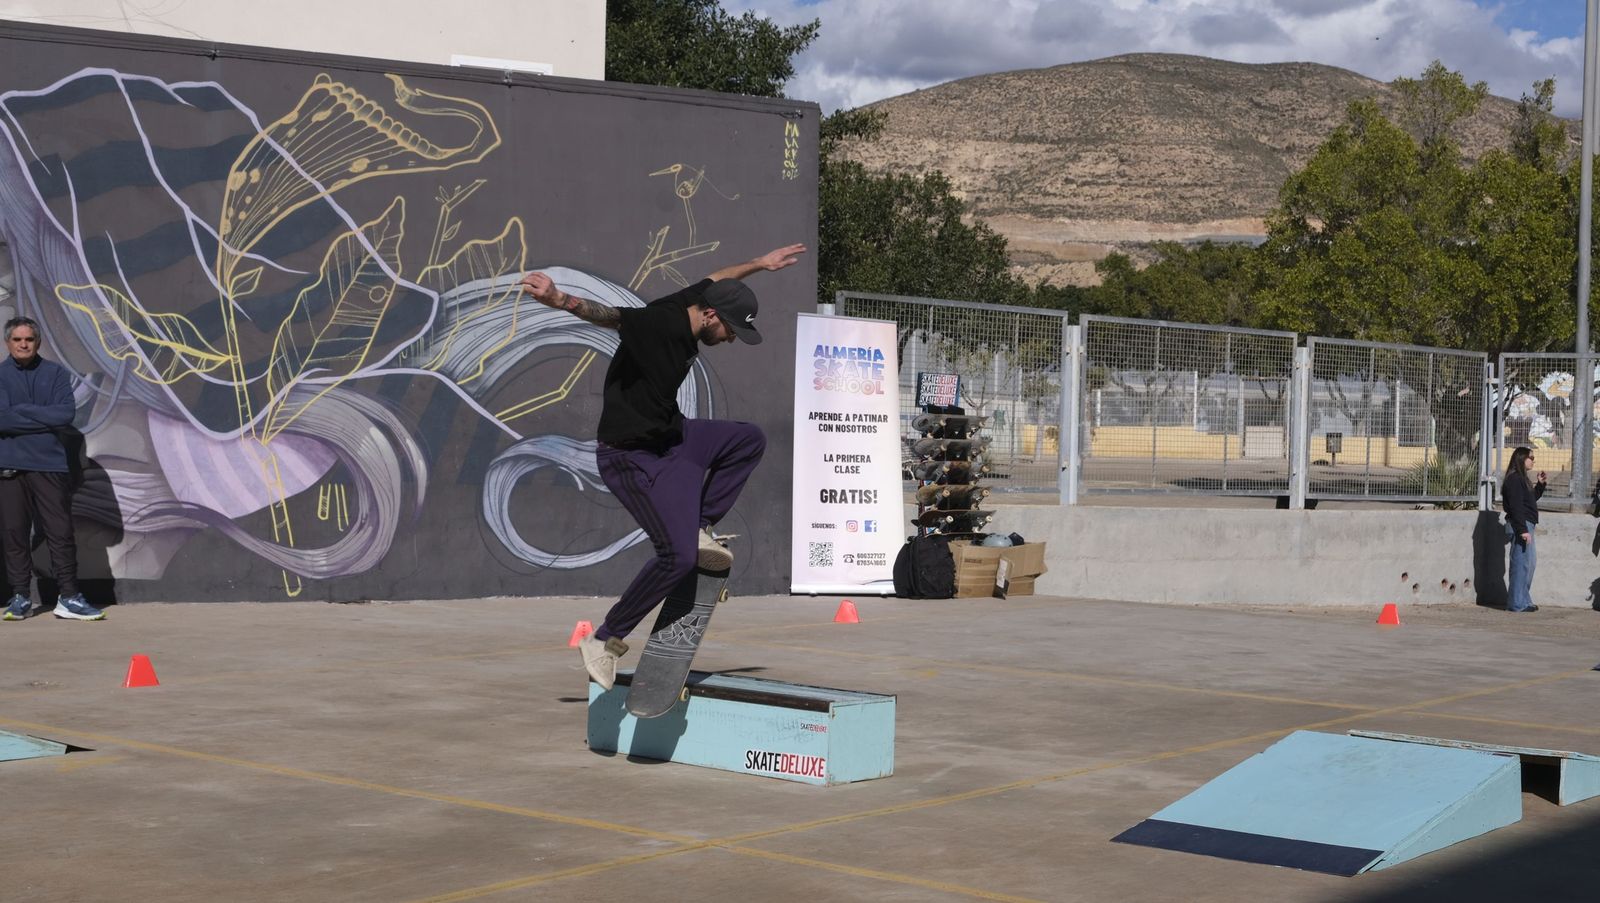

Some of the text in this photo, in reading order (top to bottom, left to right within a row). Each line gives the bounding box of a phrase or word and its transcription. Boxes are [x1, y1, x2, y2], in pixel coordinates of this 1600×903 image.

[813, 344, 885, 362] ALMERÍA
[813, 359, 885, 381] SKATE
[921, 374, 957, 385] SKATEDELUXE
[813, 377, 885, 396] SCHOOL
[920, 384, 956, 395] SKATEDELUXE
[919, 394, 955, 406] SKATEDELUXE
[808, 411, 888, 423] APRENDE A PATINAR
[818, 423, 878, 434] CON NOSOTROS
[824, 453, 872, 463] LA PRIMERA
[834, 465, 861, 474] CLASE
[820, 488, 878, 504] GRATIS!
[745, 750, 826, 778] SKATEDELUXE
